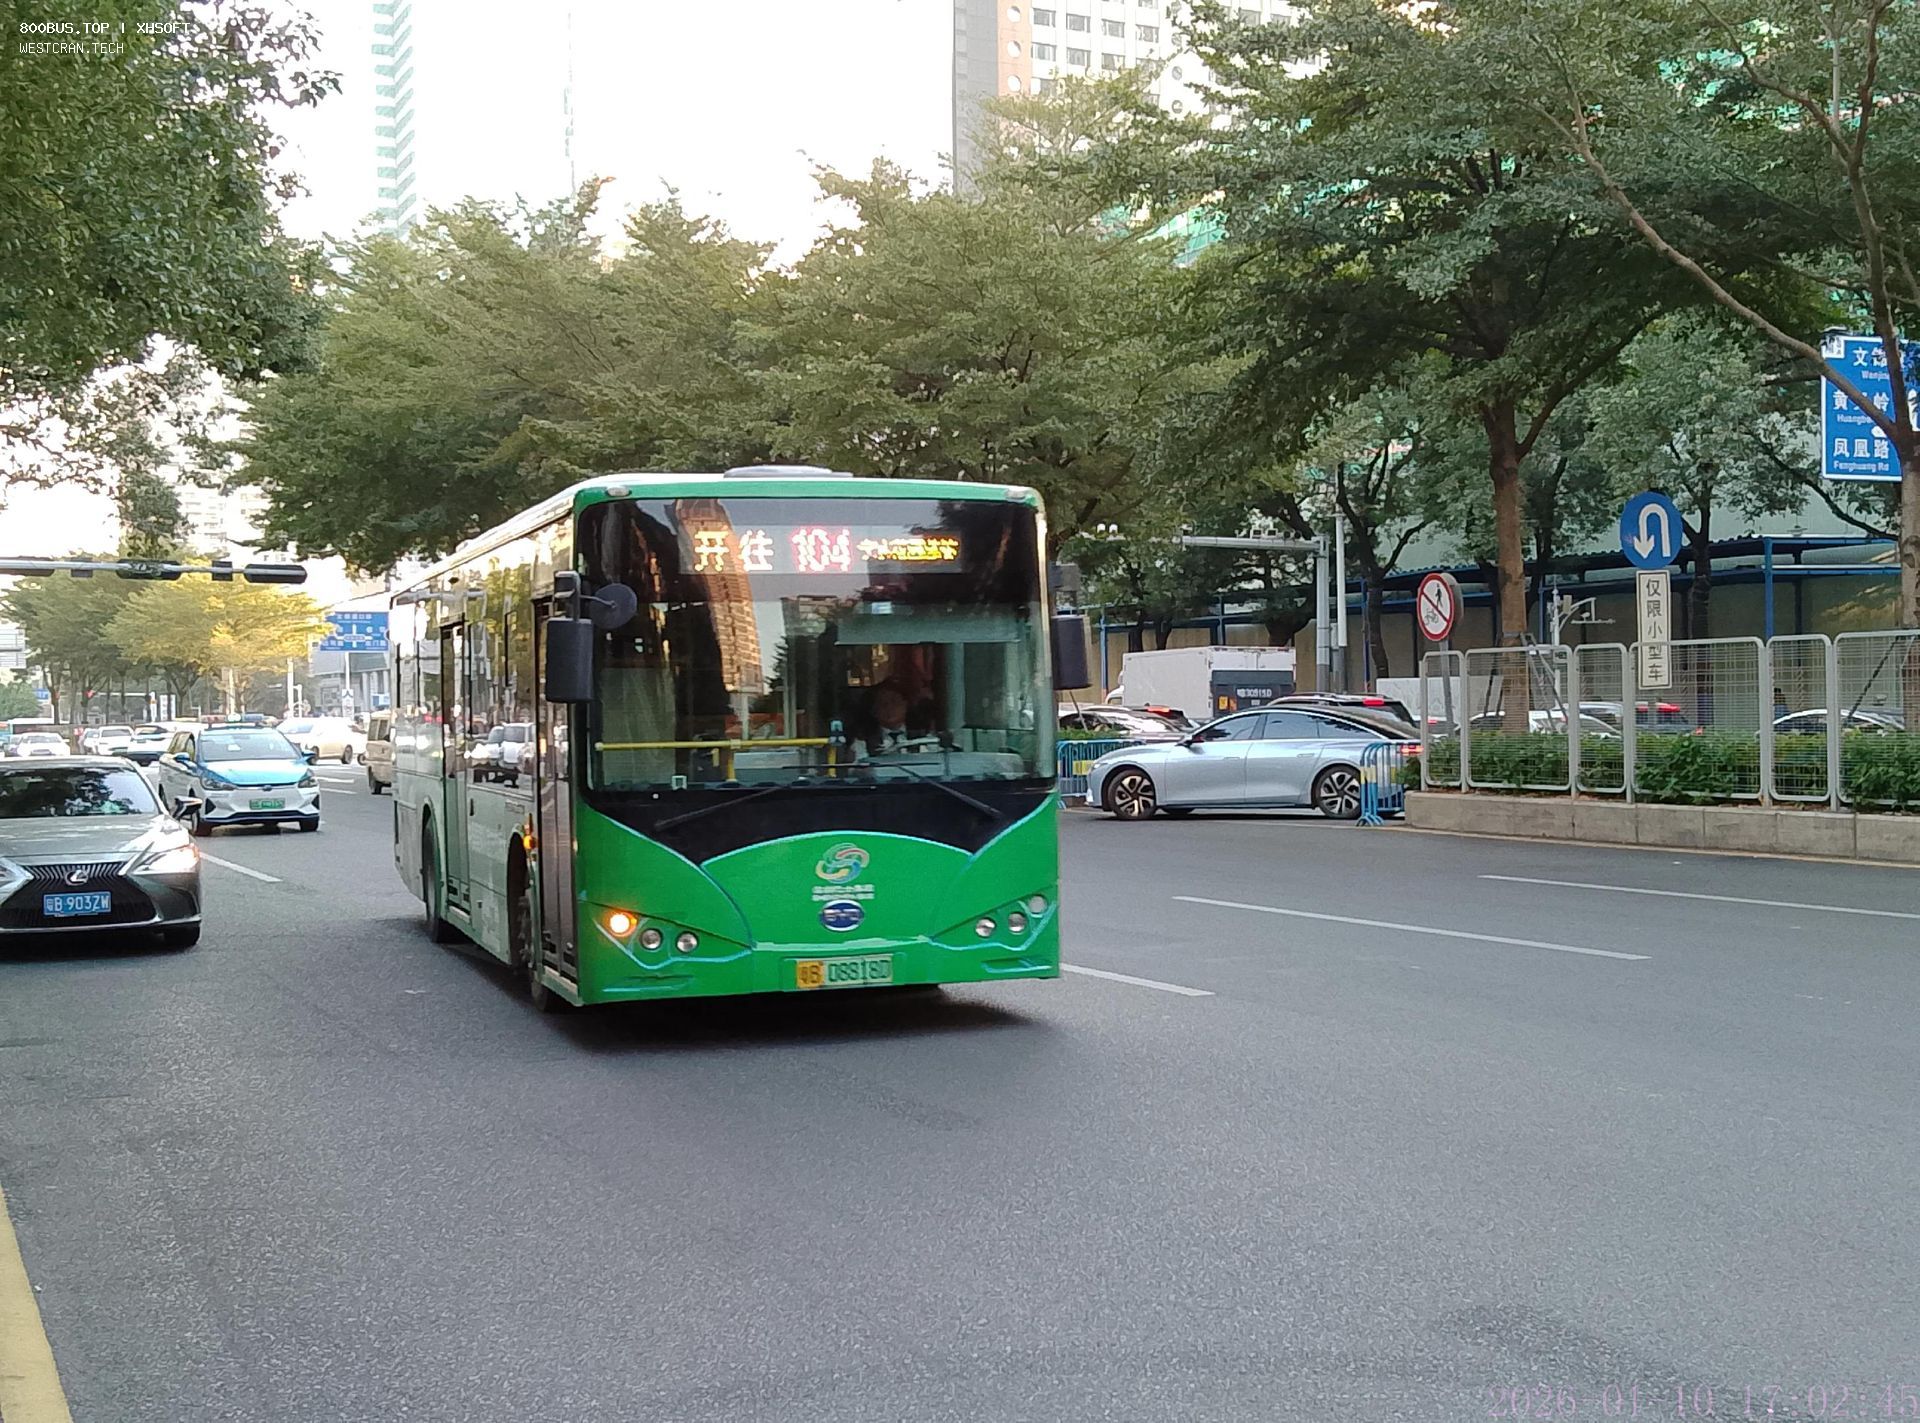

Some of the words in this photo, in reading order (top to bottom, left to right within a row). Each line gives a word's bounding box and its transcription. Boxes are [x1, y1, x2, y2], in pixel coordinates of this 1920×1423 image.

[1833, 389, 1890, 411] 黄岭
[1833, 438, 1889, 459] 凤凰路
[792, 529, 850, 572] 104
[1646, 578, 1663, 681] 仅限小型车
